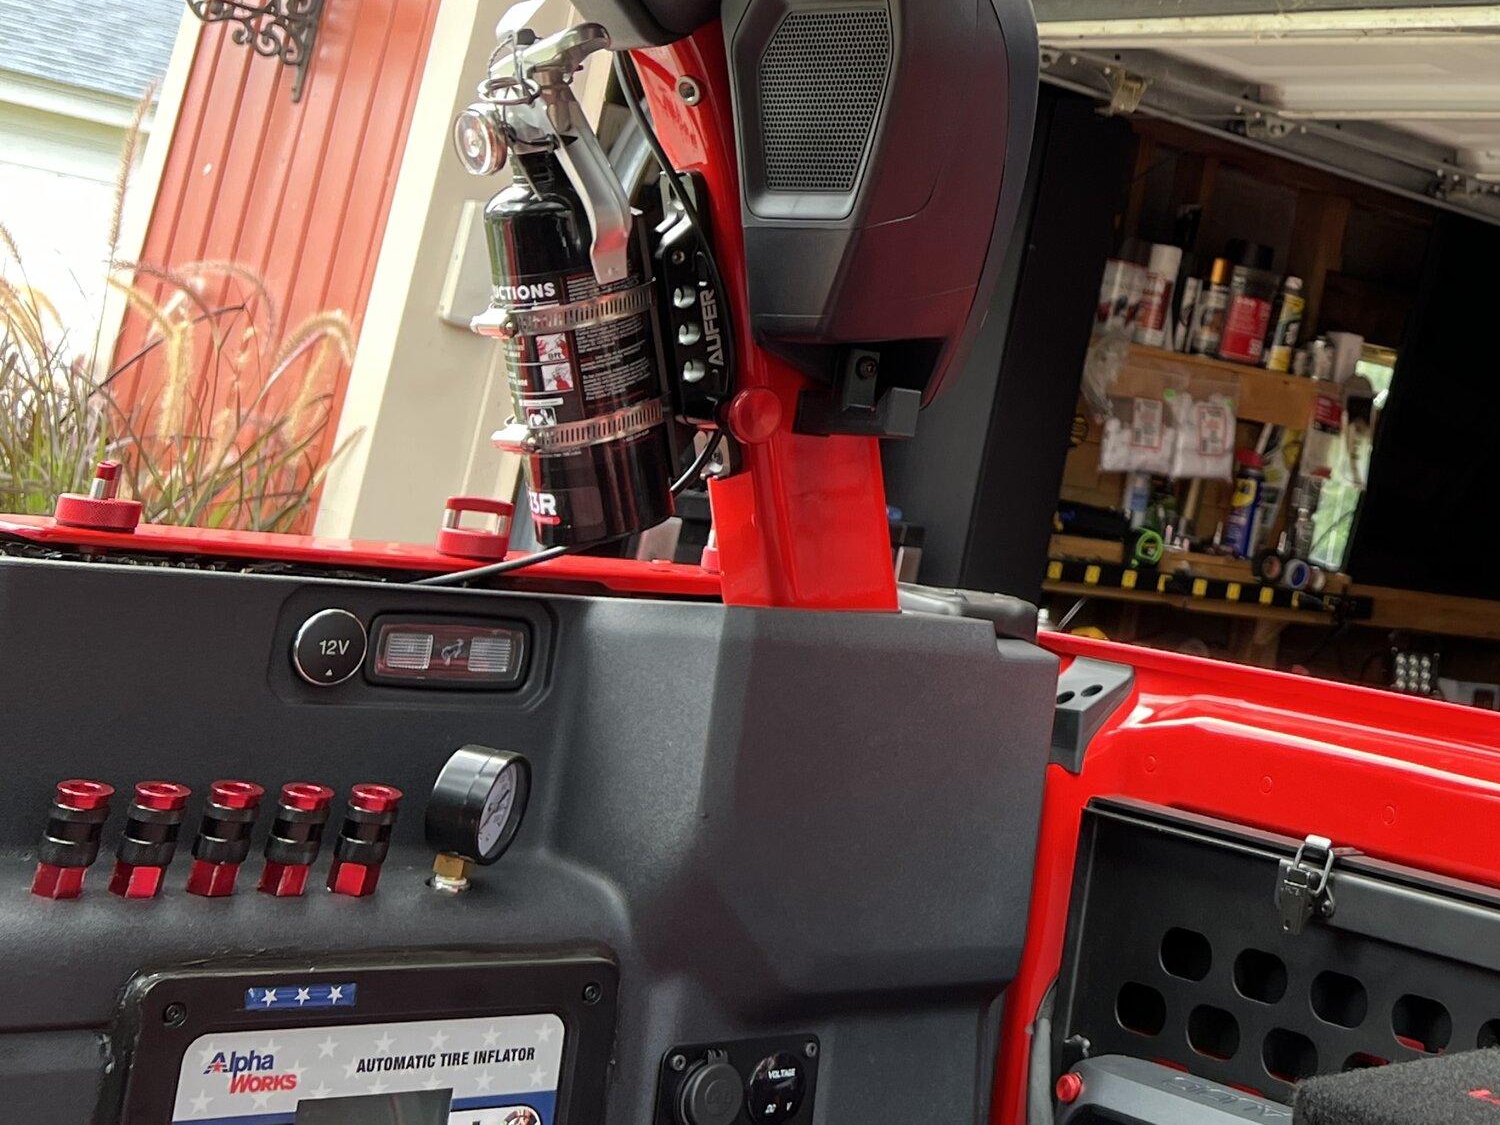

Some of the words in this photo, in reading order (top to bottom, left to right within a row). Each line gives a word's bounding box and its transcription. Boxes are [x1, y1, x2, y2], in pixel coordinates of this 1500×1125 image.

[319, 639, 351, 656] 12V
[203, 1050, 274, 1078] Alpha
[356, 1054, 436, 1073] AUTOMATIC
[440, 1051, 470, 1067] TIRE
[473, 1047, 536, 1065] INFLATOR
[229, 1073, 298, 1094] WORKS
